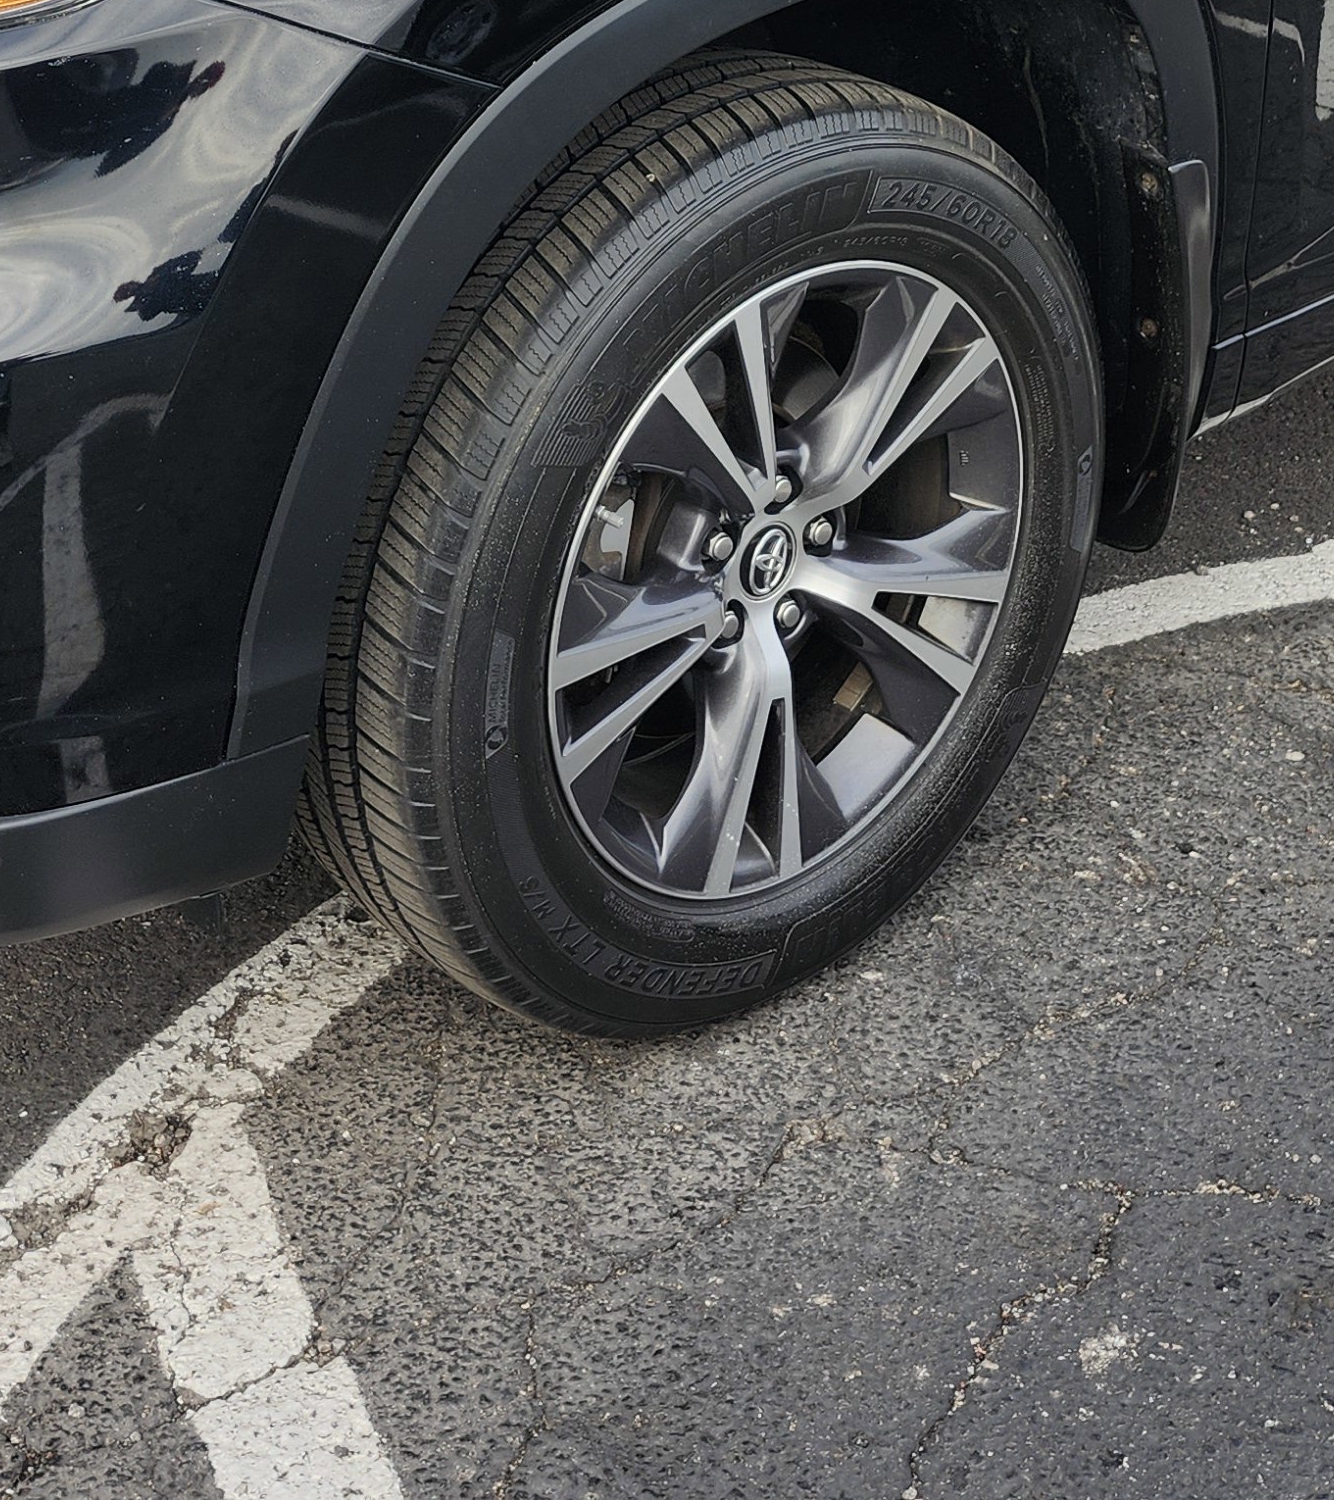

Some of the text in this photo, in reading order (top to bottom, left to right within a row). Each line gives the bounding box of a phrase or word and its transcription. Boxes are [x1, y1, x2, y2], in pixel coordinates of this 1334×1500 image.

[883, 180, 1015, 249] 245/60R18
[622, 180, 859, 358] MICHELIN
[486, 662, 502, 721] MICHELIN
[519, 876, 556, 921] M/S
[547, 913, 607, 966] LTX
[605, 951, 765, 996] DEFENDER
